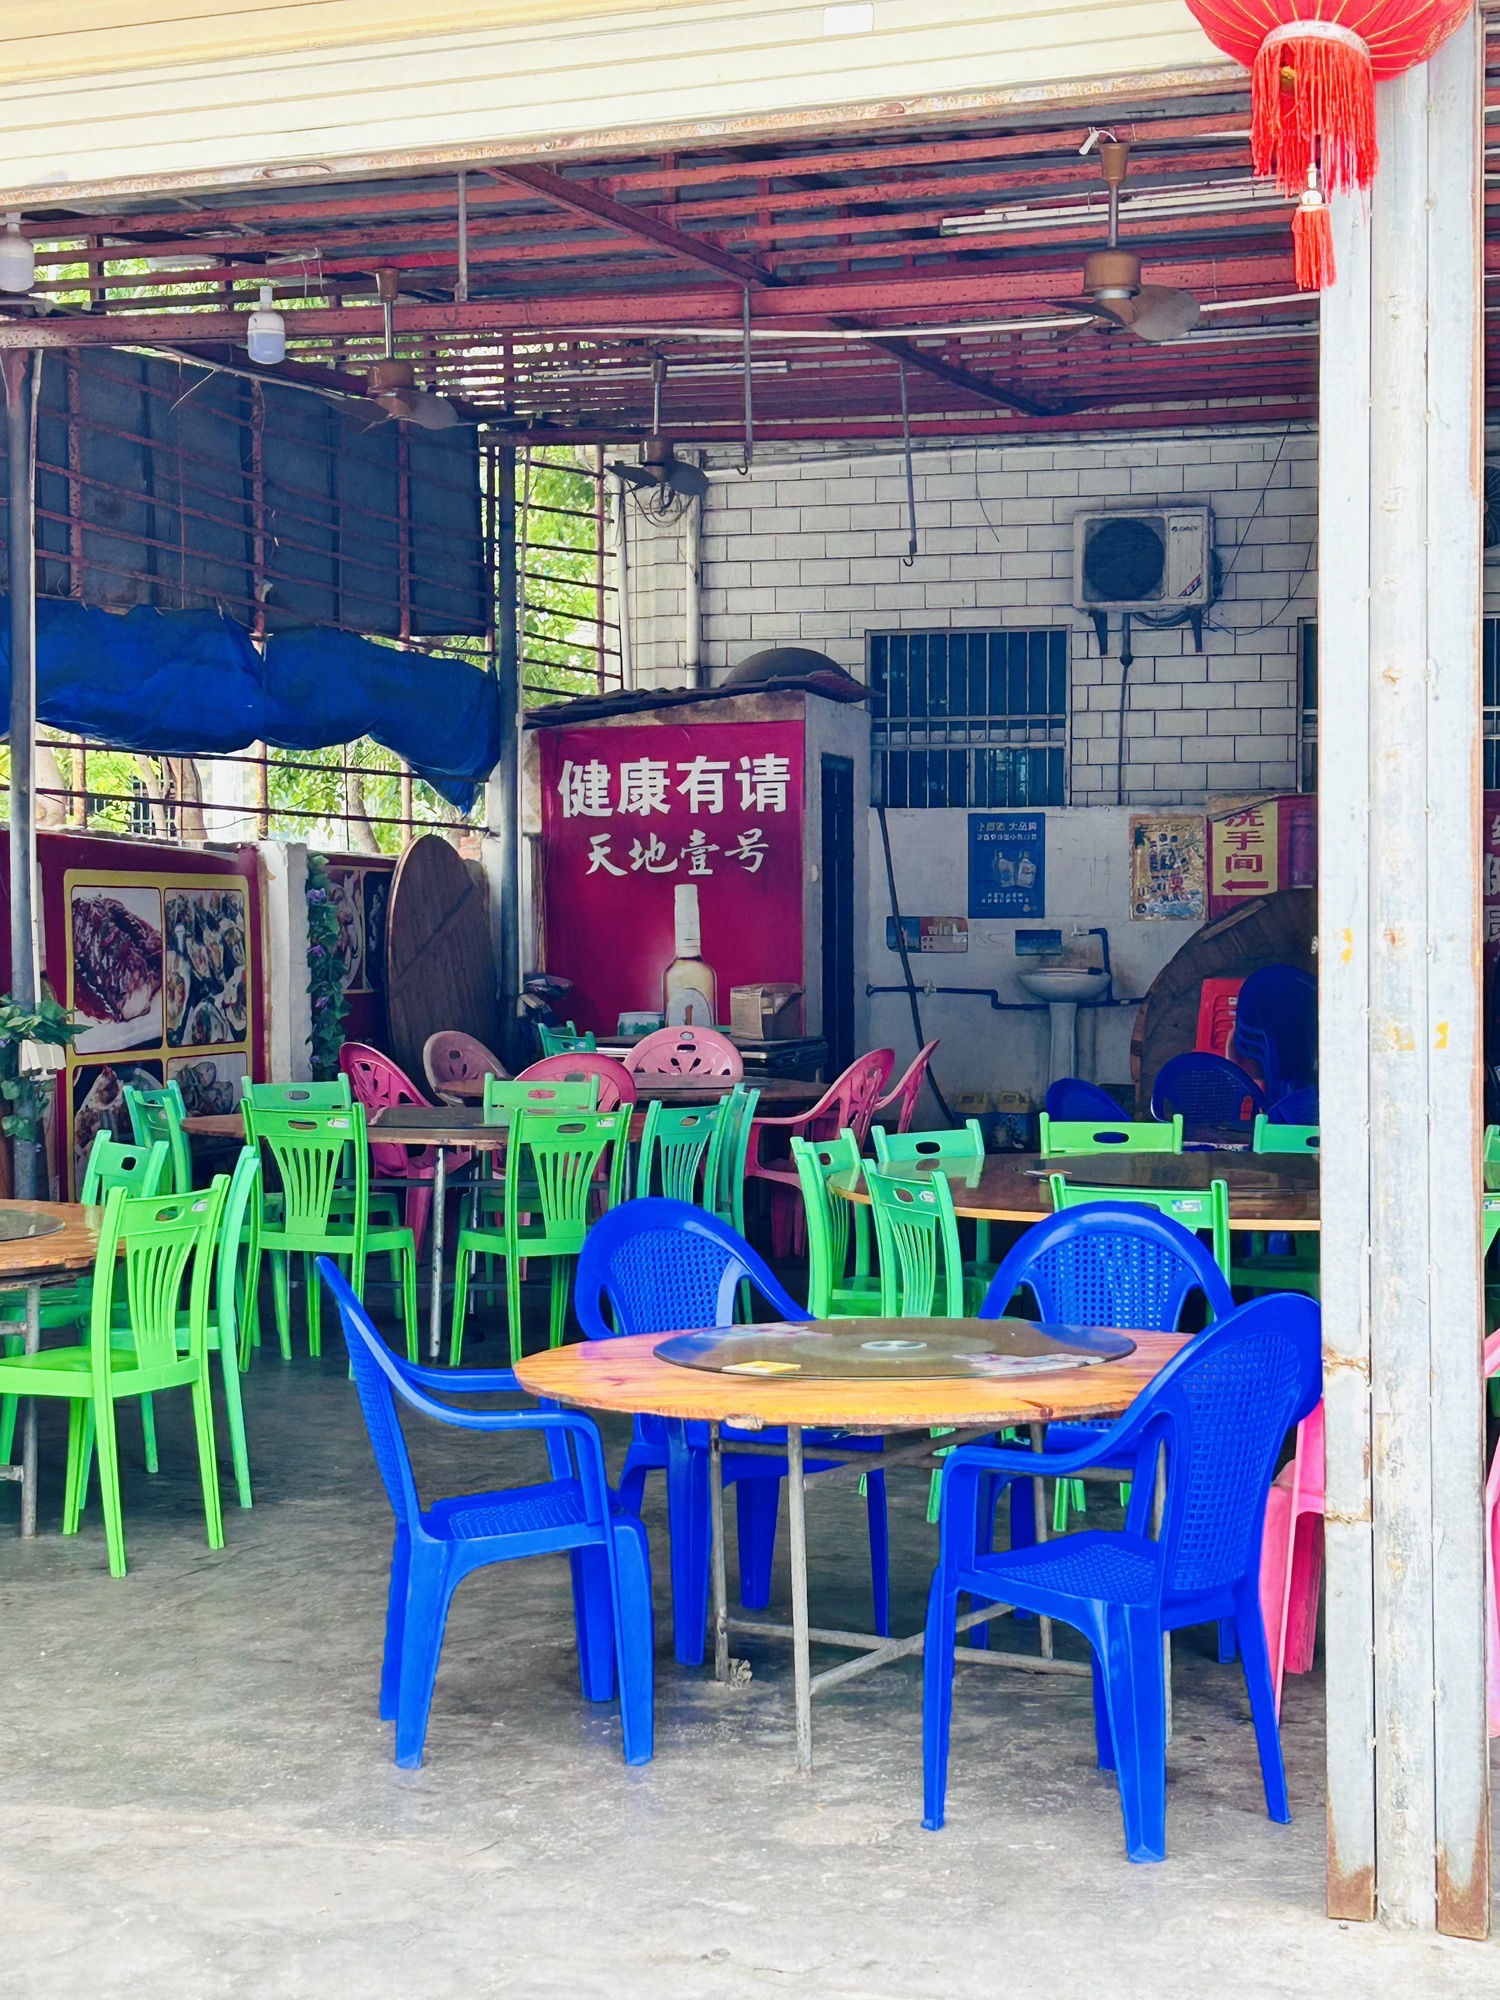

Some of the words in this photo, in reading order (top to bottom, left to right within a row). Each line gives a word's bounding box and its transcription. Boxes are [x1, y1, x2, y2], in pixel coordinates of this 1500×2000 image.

[558, 753, 790, 817] 健康有请
[586, 828, 768, 875] 天地壹号
